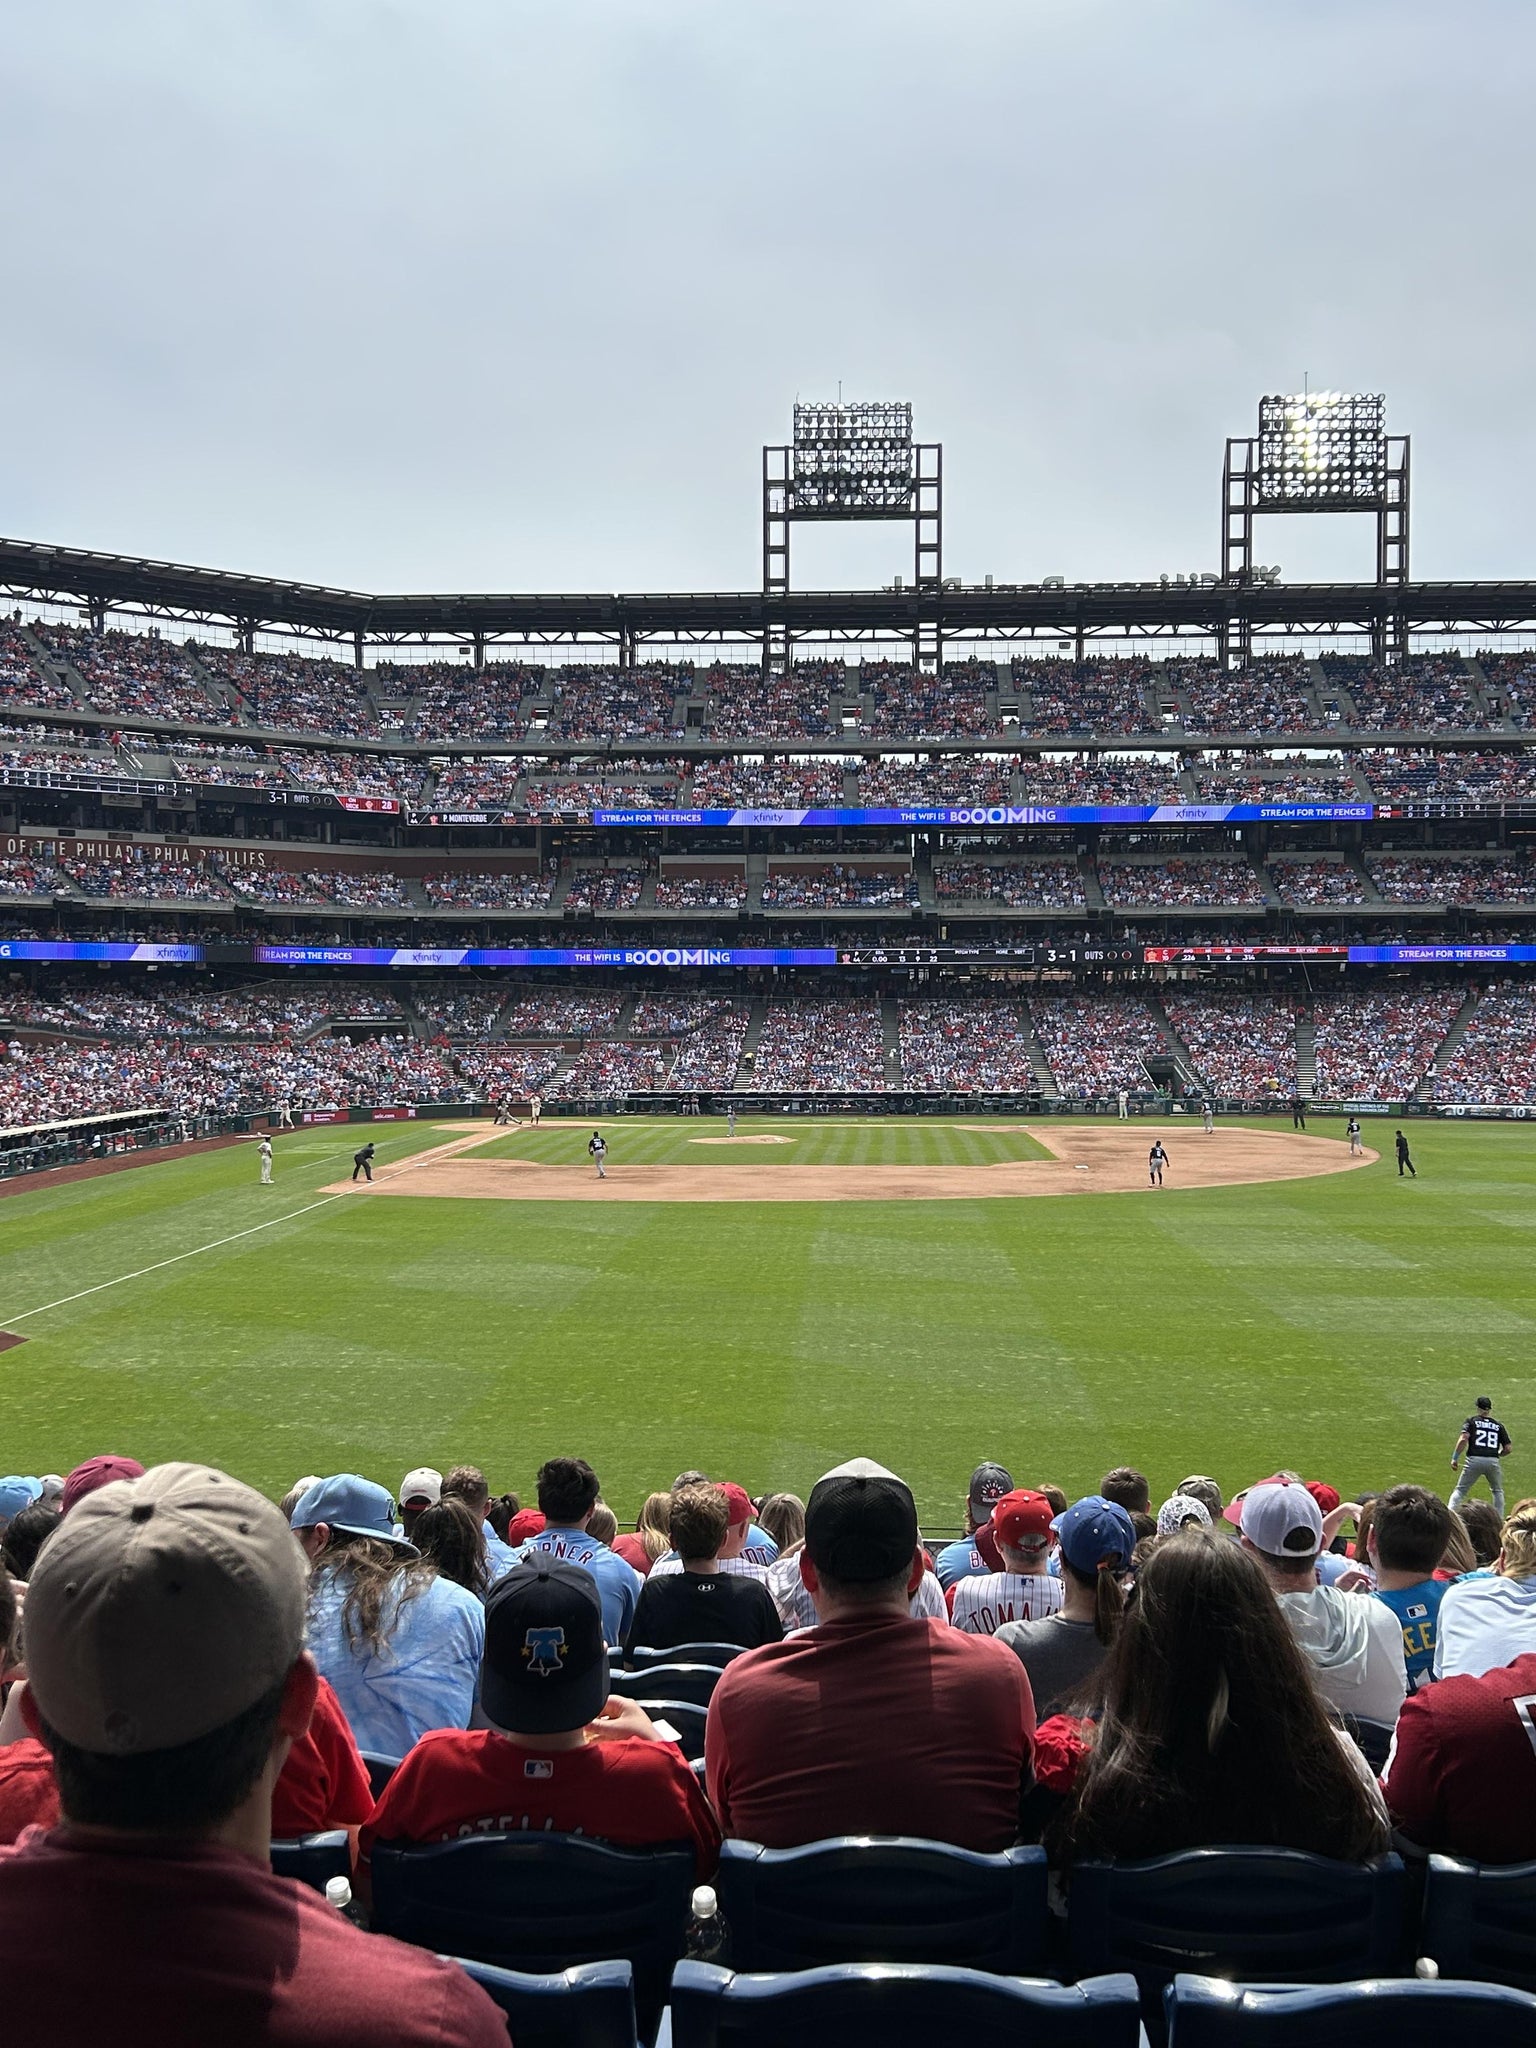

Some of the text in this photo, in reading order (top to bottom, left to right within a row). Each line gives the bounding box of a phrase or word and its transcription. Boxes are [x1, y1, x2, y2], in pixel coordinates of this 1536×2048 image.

[158, 784, 165, 793] R
[269, 791, 310, 804] 3-1 OUTS
[381, 801, 393, 810] 28
[900, 808, 1056, 824] THE WIFI IS BOOOMING
[1175, 808, 1207, 819] xfinity
[1260, 808, 1366, 817] STREAM FOR THE FENCES
[449, 814, 488, 823] MONTEVERDE
[601, 814, 701, 823] STREAM FOR THE FENCES
[753, 813, 784, 823] xfinity
[7, 838, 26, 854] OF
[76, 842, 190, 862] PHILADPHIA
[157, 949, 189, 959] xfinity
[290, 951, 306, 960] FOR
[307, 951, 322, 960] THE
[323, 952, 352, 960] FENCES
[412, 953, 442, 963] xfinity
[575, 949, 730, 965] THE WIFI IS BOOOMING
[1084, 950, 1104, 960] OUTS
[1399, 949, 1507, 958] STREAM FOR THE FENCES
[1475, 1429, 1499, 1449] 28
